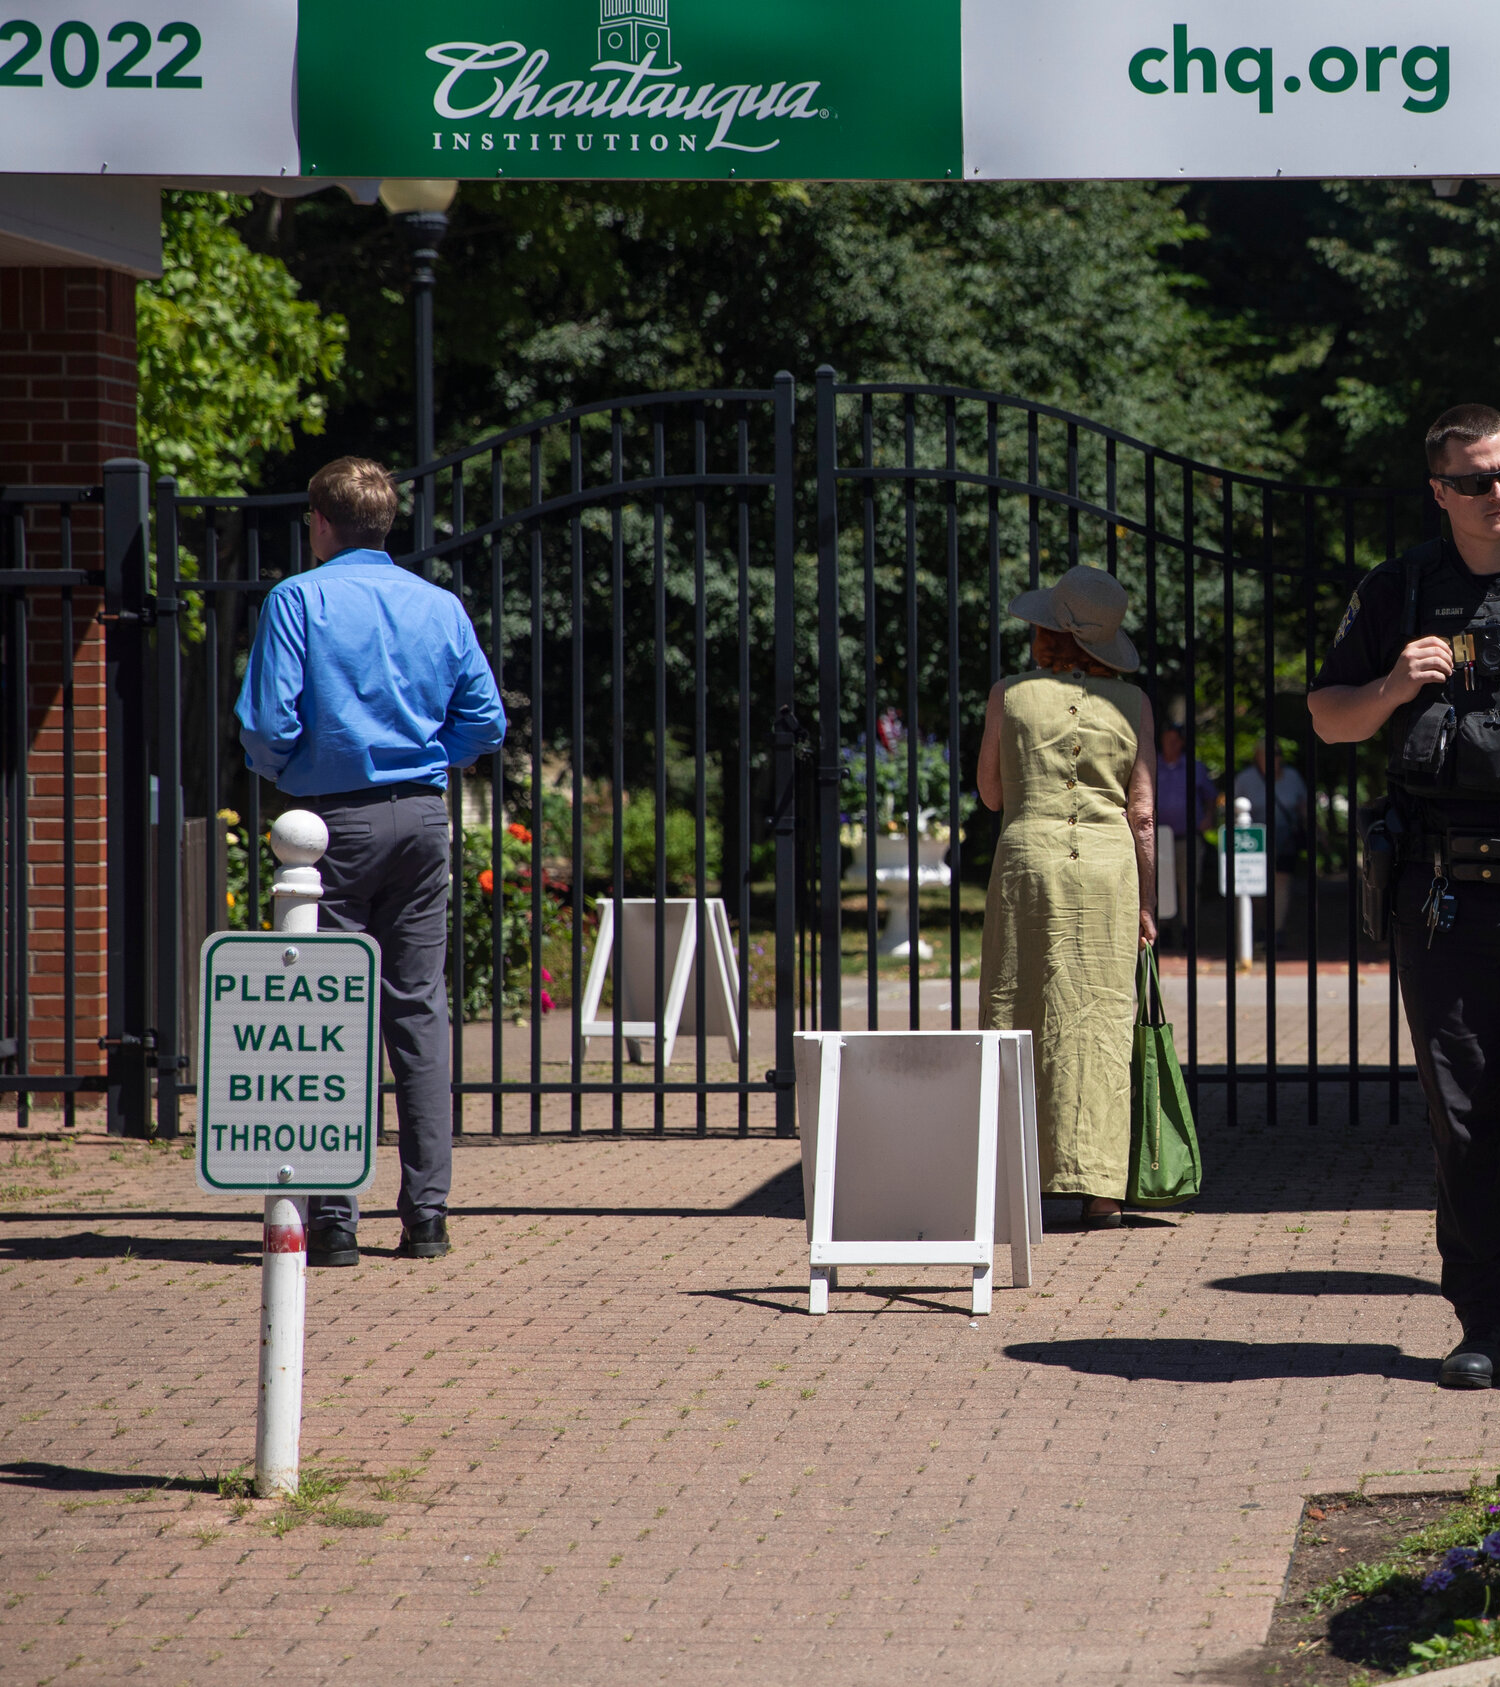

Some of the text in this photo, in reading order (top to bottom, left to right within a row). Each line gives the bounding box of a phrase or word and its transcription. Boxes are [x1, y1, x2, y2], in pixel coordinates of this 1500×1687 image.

[0, 20, 202, 88] 2022
[1128, 23, 1450, 113] chq.org
[432, 132, 697, 152] INSTITUTION
[214, 974, 365, 1002] PLEASE
[233, 1024, 345, 1051] WALK
[229, 1075, 346, 1101] BIKES
[211, 1124, 363, 1151] THROUGH
